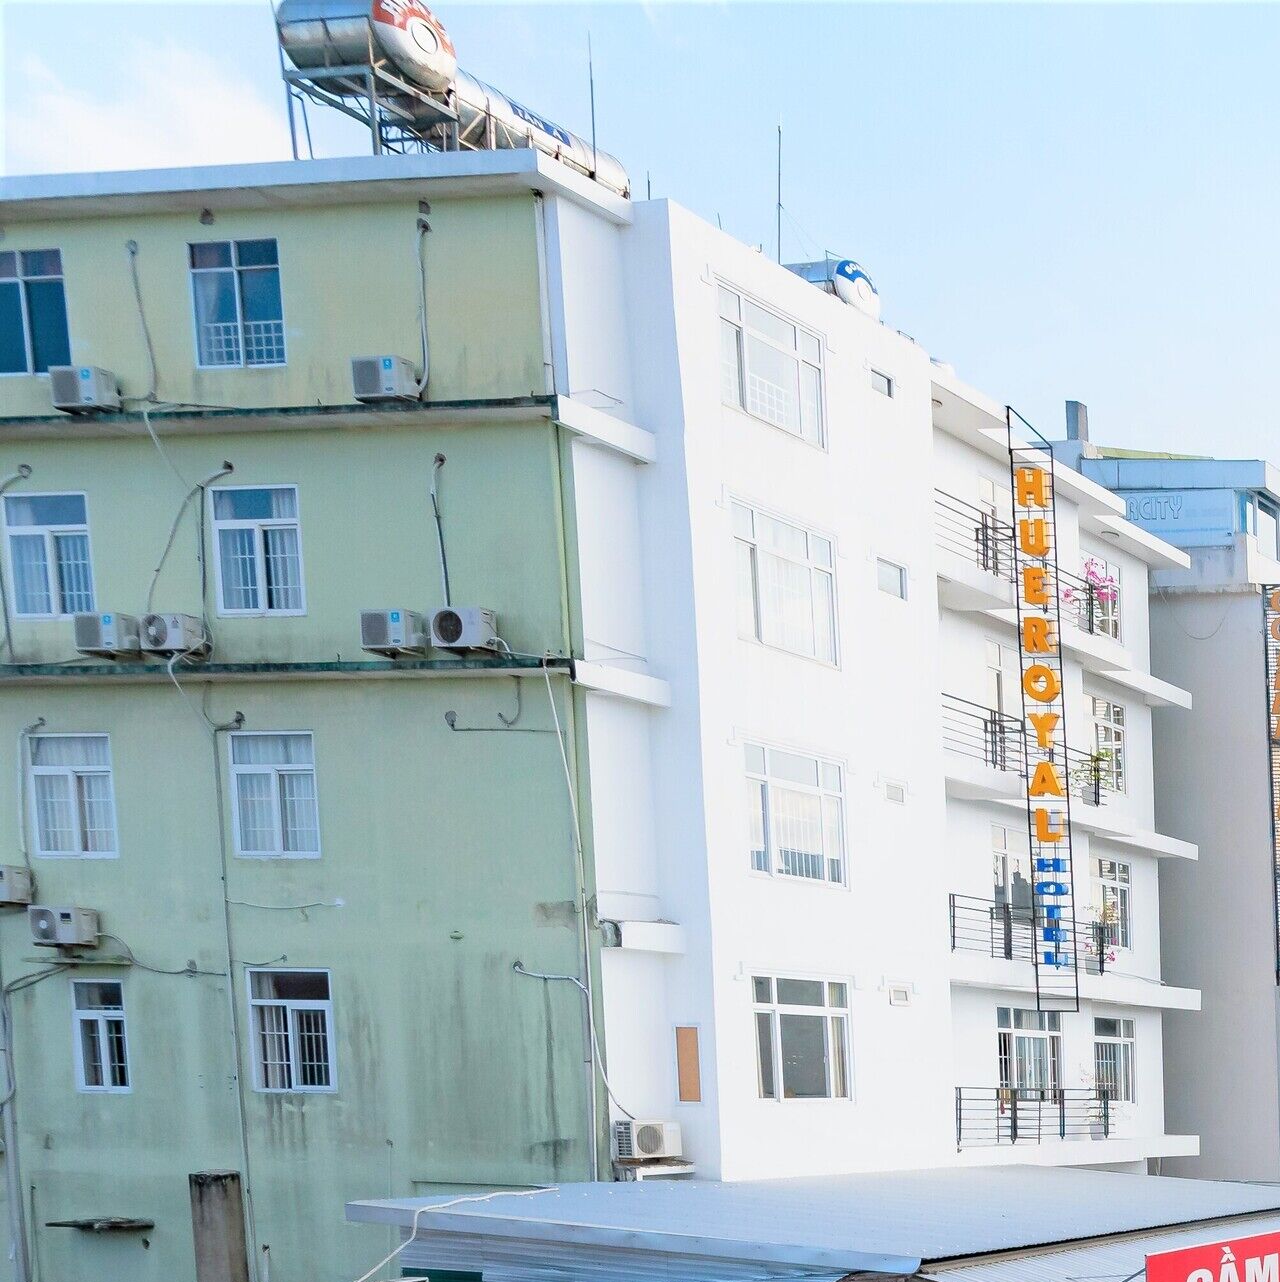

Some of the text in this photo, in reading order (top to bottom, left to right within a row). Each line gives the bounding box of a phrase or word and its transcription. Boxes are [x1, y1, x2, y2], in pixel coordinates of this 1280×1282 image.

[1016, 467, 1068, 968] HUE ROYAL HOTEL
